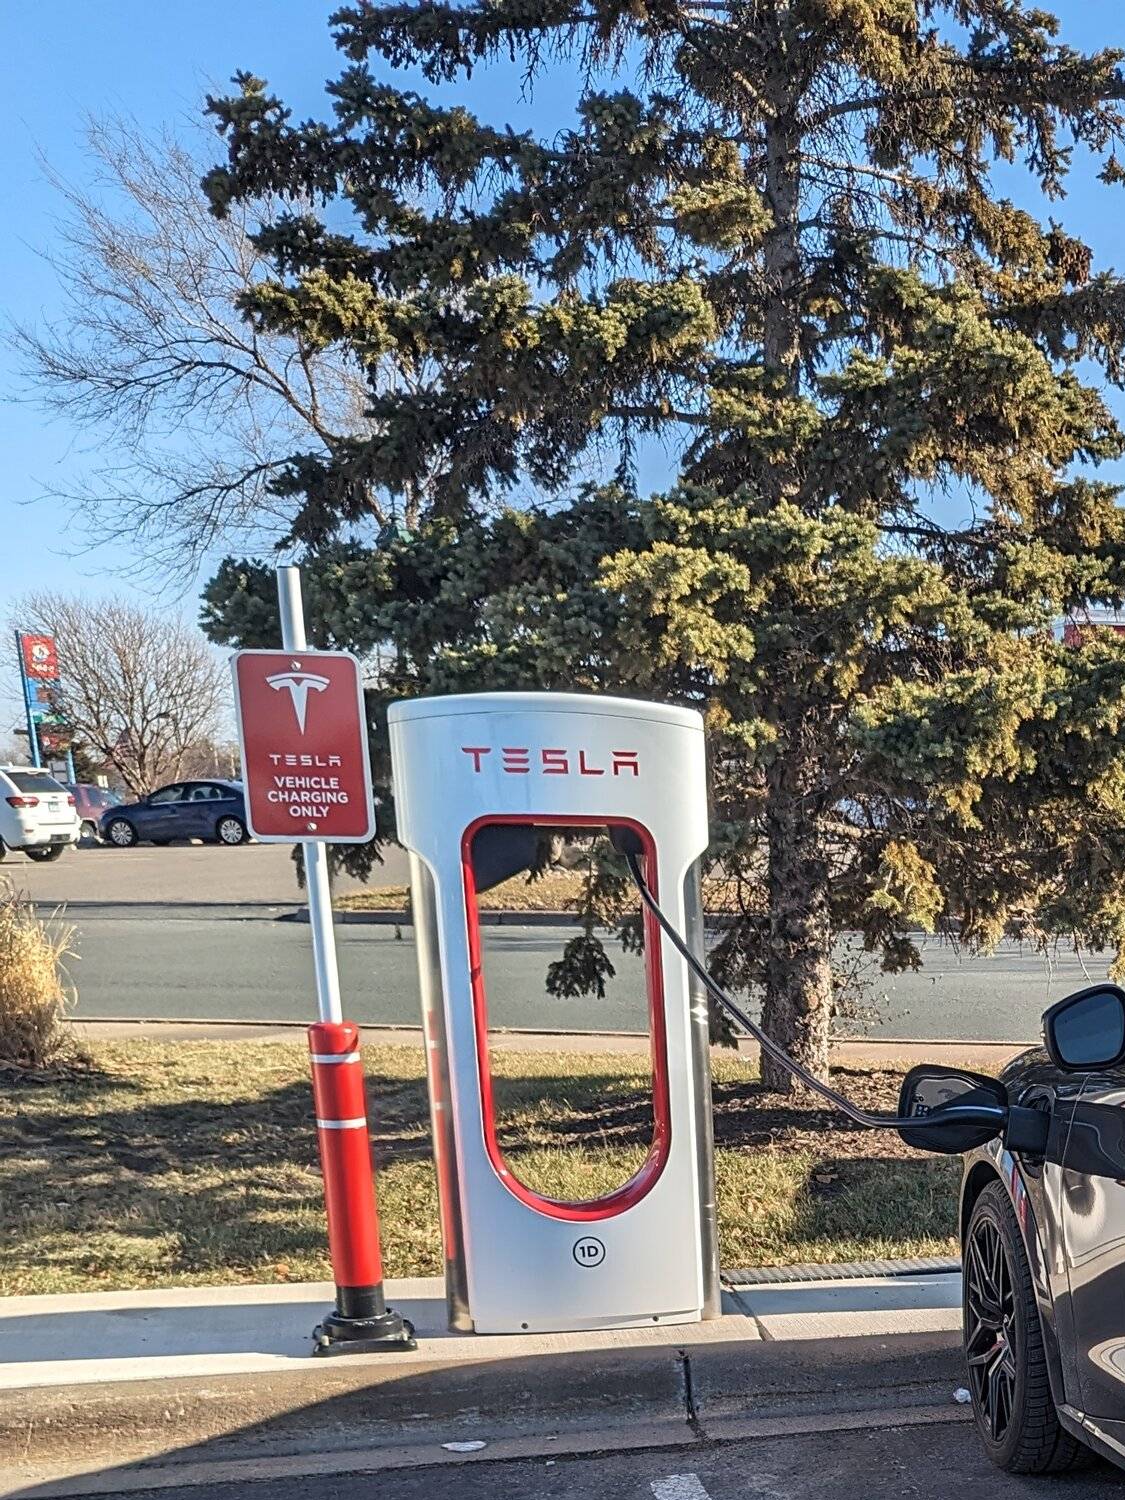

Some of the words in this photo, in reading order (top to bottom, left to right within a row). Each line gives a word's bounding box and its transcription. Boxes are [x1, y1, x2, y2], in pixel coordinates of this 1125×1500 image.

[269, 754, 342, 767] TESLA
[461, 747, 639, 777] TESLA
[274, 776, 340, 789] VEHICLE
[267, 790, 349, 804] CHARGING
[289, 805, 330, 818] ONLY
[579, 1245, 599, 1258] 1D
